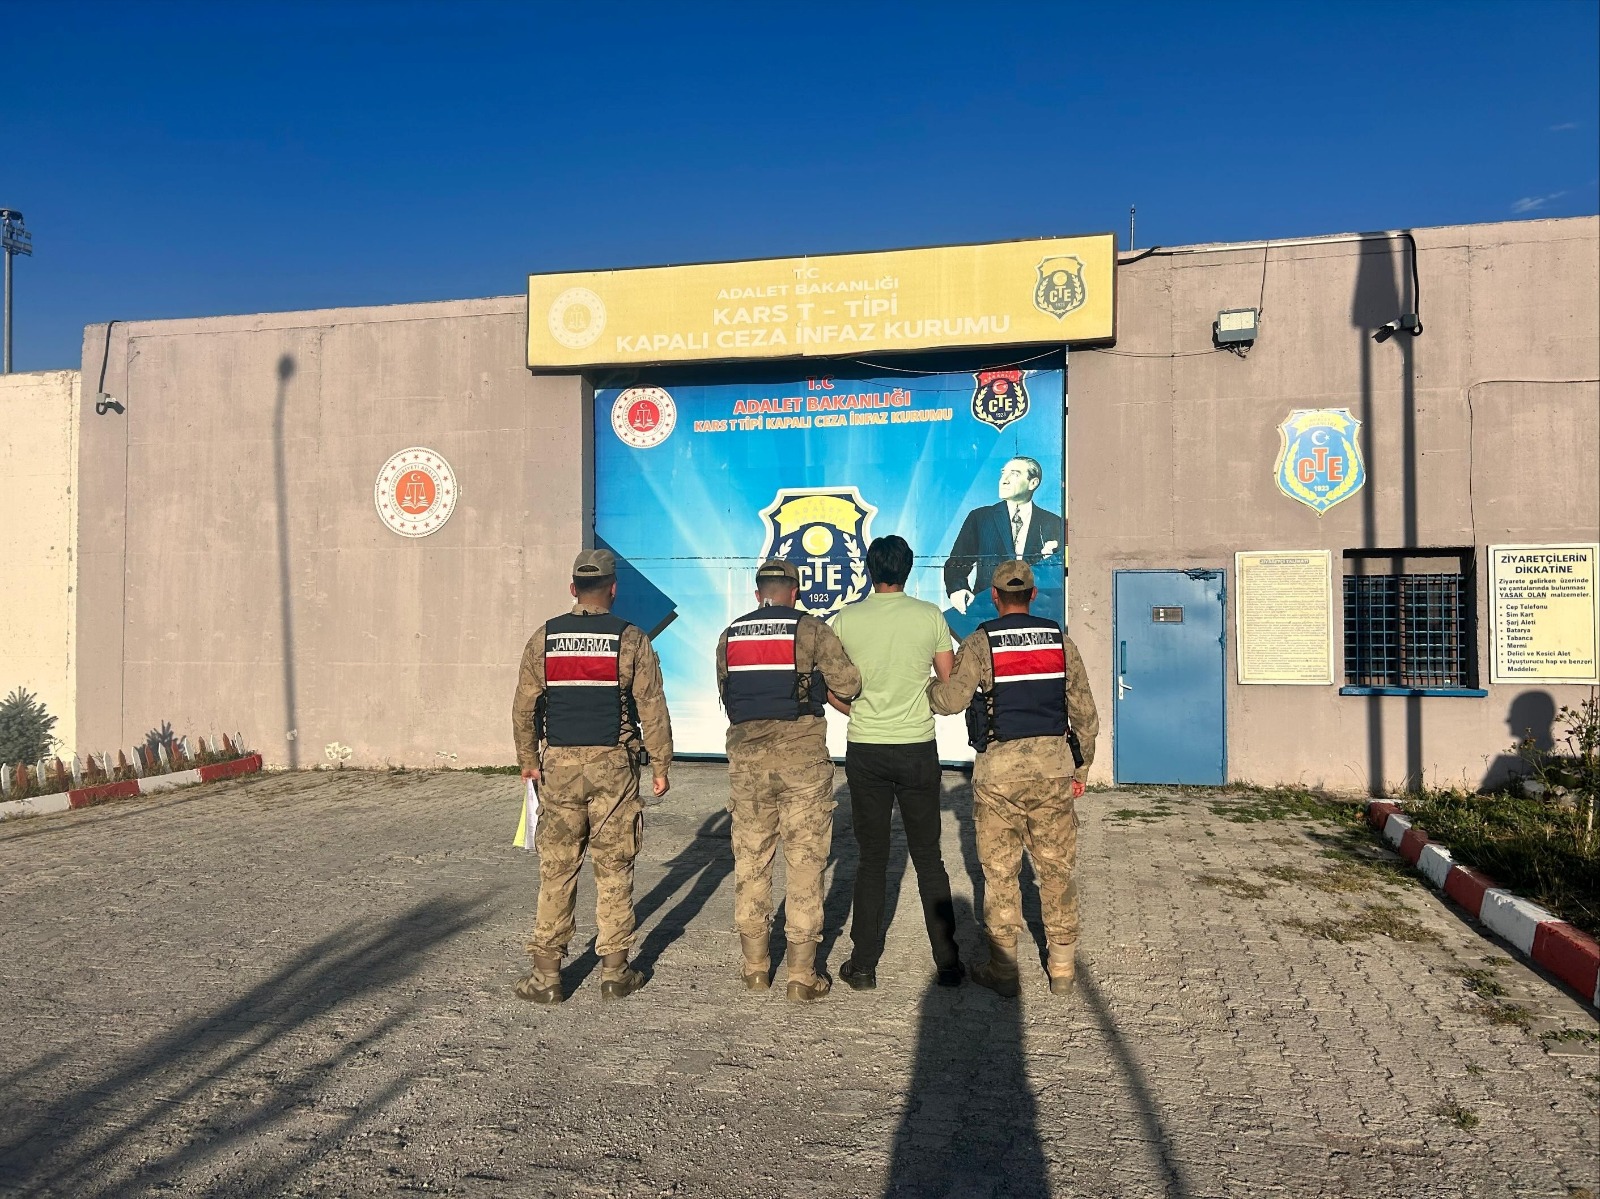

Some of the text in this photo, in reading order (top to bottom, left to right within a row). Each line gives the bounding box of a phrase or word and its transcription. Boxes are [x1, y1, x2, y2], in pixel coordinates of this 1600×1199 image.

[717, 276, 899, 300] ADALET BAKANLIĞI
[1050, 286, 1071, 302] CTE
[713, 304, 788, 326] KARS
[796, 304, 814, 320] T
[844, 293, 897, 317] TİPİ
[616, 315, 1010, 352] KAPALI CEZA İNFAZ KURUMU
[806, 374, 834, 390] T.C
[733, 388, 911, 415] ADALET BAKANLIĞI
[989, 395, 1012, 412] CTE
[694, 408, 952, 432] KARS T TİPİ KAPALI CEZA İNFAZ KURUMU
[1298, 447, 1343, 483] CTE
[1501, 553, 1587, 564] ZİYARETÇİLERİN
[798, 558, 841, 591] CTE
[1516, 564, 1573, 573] DİKKATİNE
[809, 594, 829, 602] 1923
[734, 623, 788, 636] JANDARMA
[552, 638, 611, 651] JANDARMA
[998, 632, 1055, 646] JANDARMA
